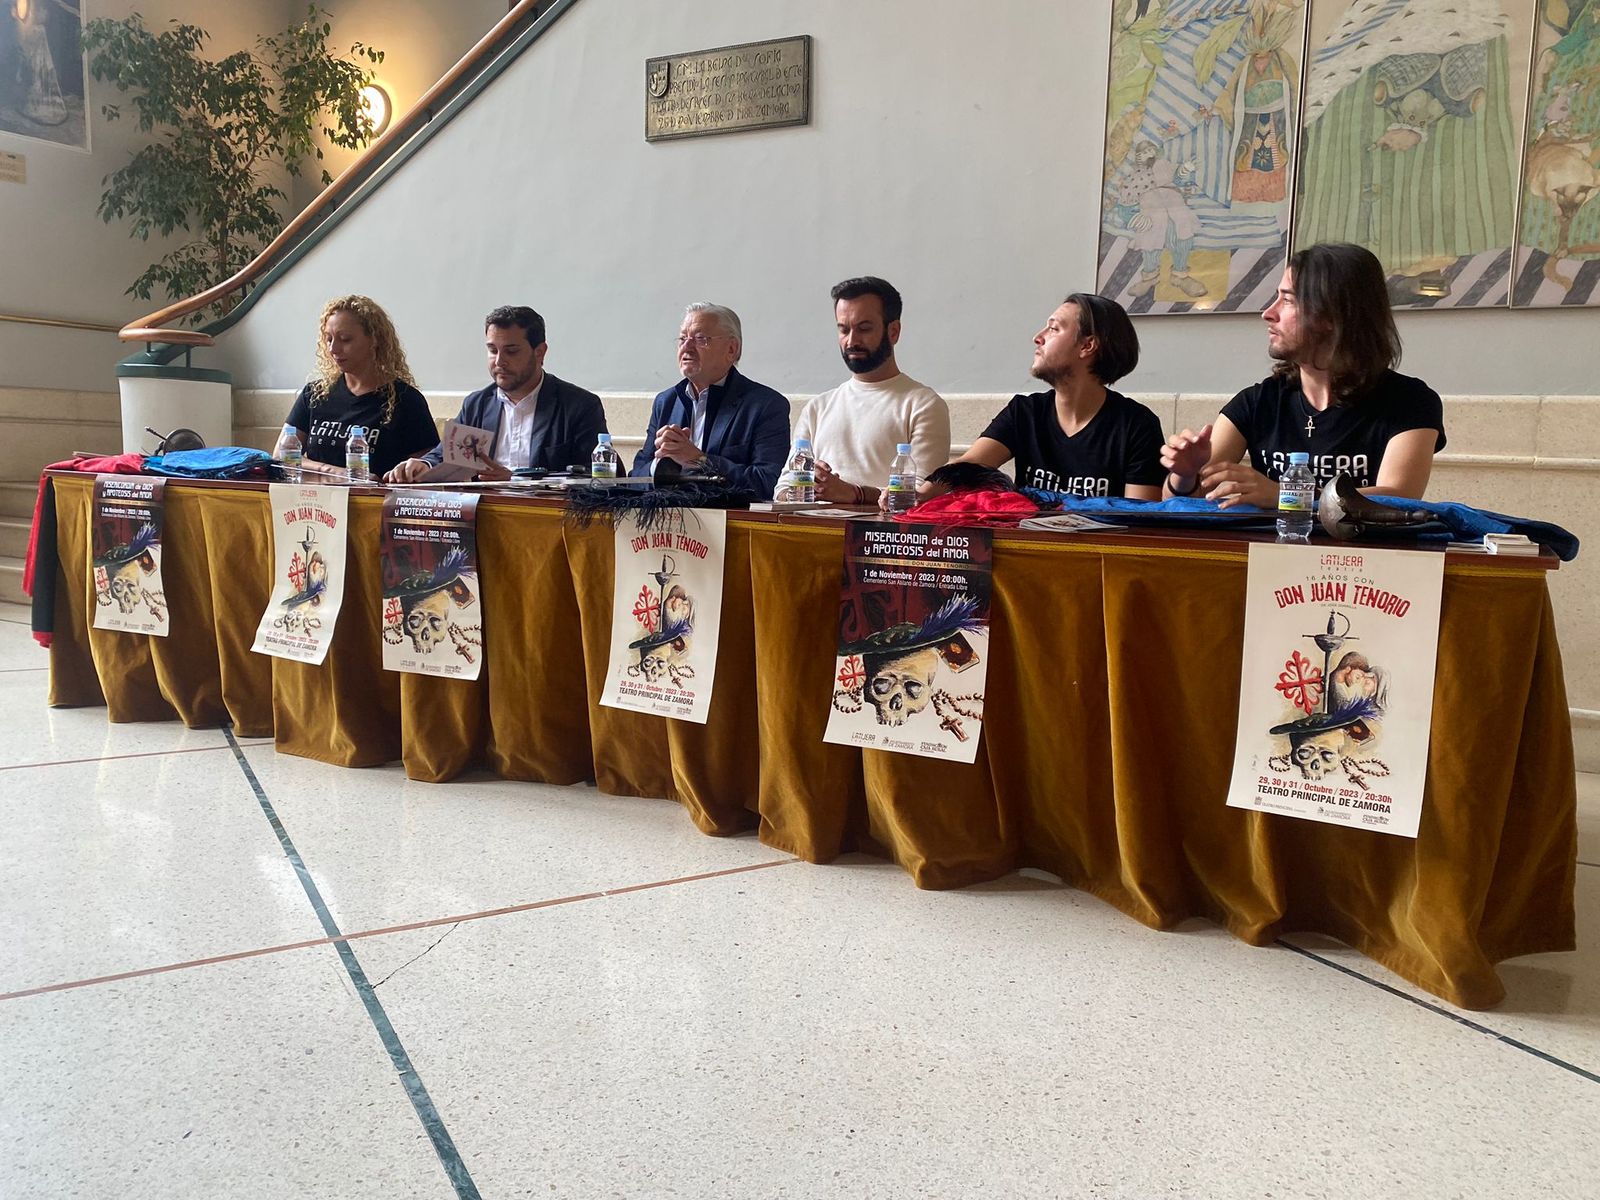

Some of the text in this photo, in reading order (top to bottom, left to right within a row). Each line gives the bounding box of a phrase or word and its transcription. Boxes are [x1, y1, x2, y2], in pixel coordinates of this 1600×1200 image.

[309, 436, 375, 454] teao
[395, 497, 437, 508] MISERICORDIA
[447, 500, 463, 509] DIOS
[284, 507, 337, 529] DON JUAN TENORIO
[394, 507, 462, 518] y APOTEOSIS del AMOR
[630, 532, 709, 560] DON JUAN TENORIO
[864, 531, 969, 547] MISERICORDIA de DIOS
[864, 543, 969, 560] y APOTEOSIS del AMOR
[943, 562, 970, 570] TENORIO
[1320, 554, 1363, 567] LATIJERA
[869, 569, 878, 578] de
[879, 570, 912, 580] Noviembre
[918, 573, 935, 582] 2023
[941, 574, 968, 585] 20:00h.
[1321, 573, 1348, 581] AÑOS
[1353, 576, 1374, 585] CON
[1274, 581, 1411, 618] DON JUAN TENORIO
[619, 687, 694, 706] TEATRO PRINCIPAL DE ZAMORA
[1271, 777, 1282, 786] 30
[1282, 780, 1288, 789] y
[1288, 780, 1298, 789] 31
[1304, 782, 1334, 795] Octubre
[1339, 787, 1359, 799] 2023
[1365, 791, 1392, 804] 20:30h
[1257, 784, 1289, 798] TEATRO
[1290, 790, 1337, 805] PRINCIPAL
[1338, 796, 1350, 808] DE
[1352, 799, 1392, 815] ZAMORA
